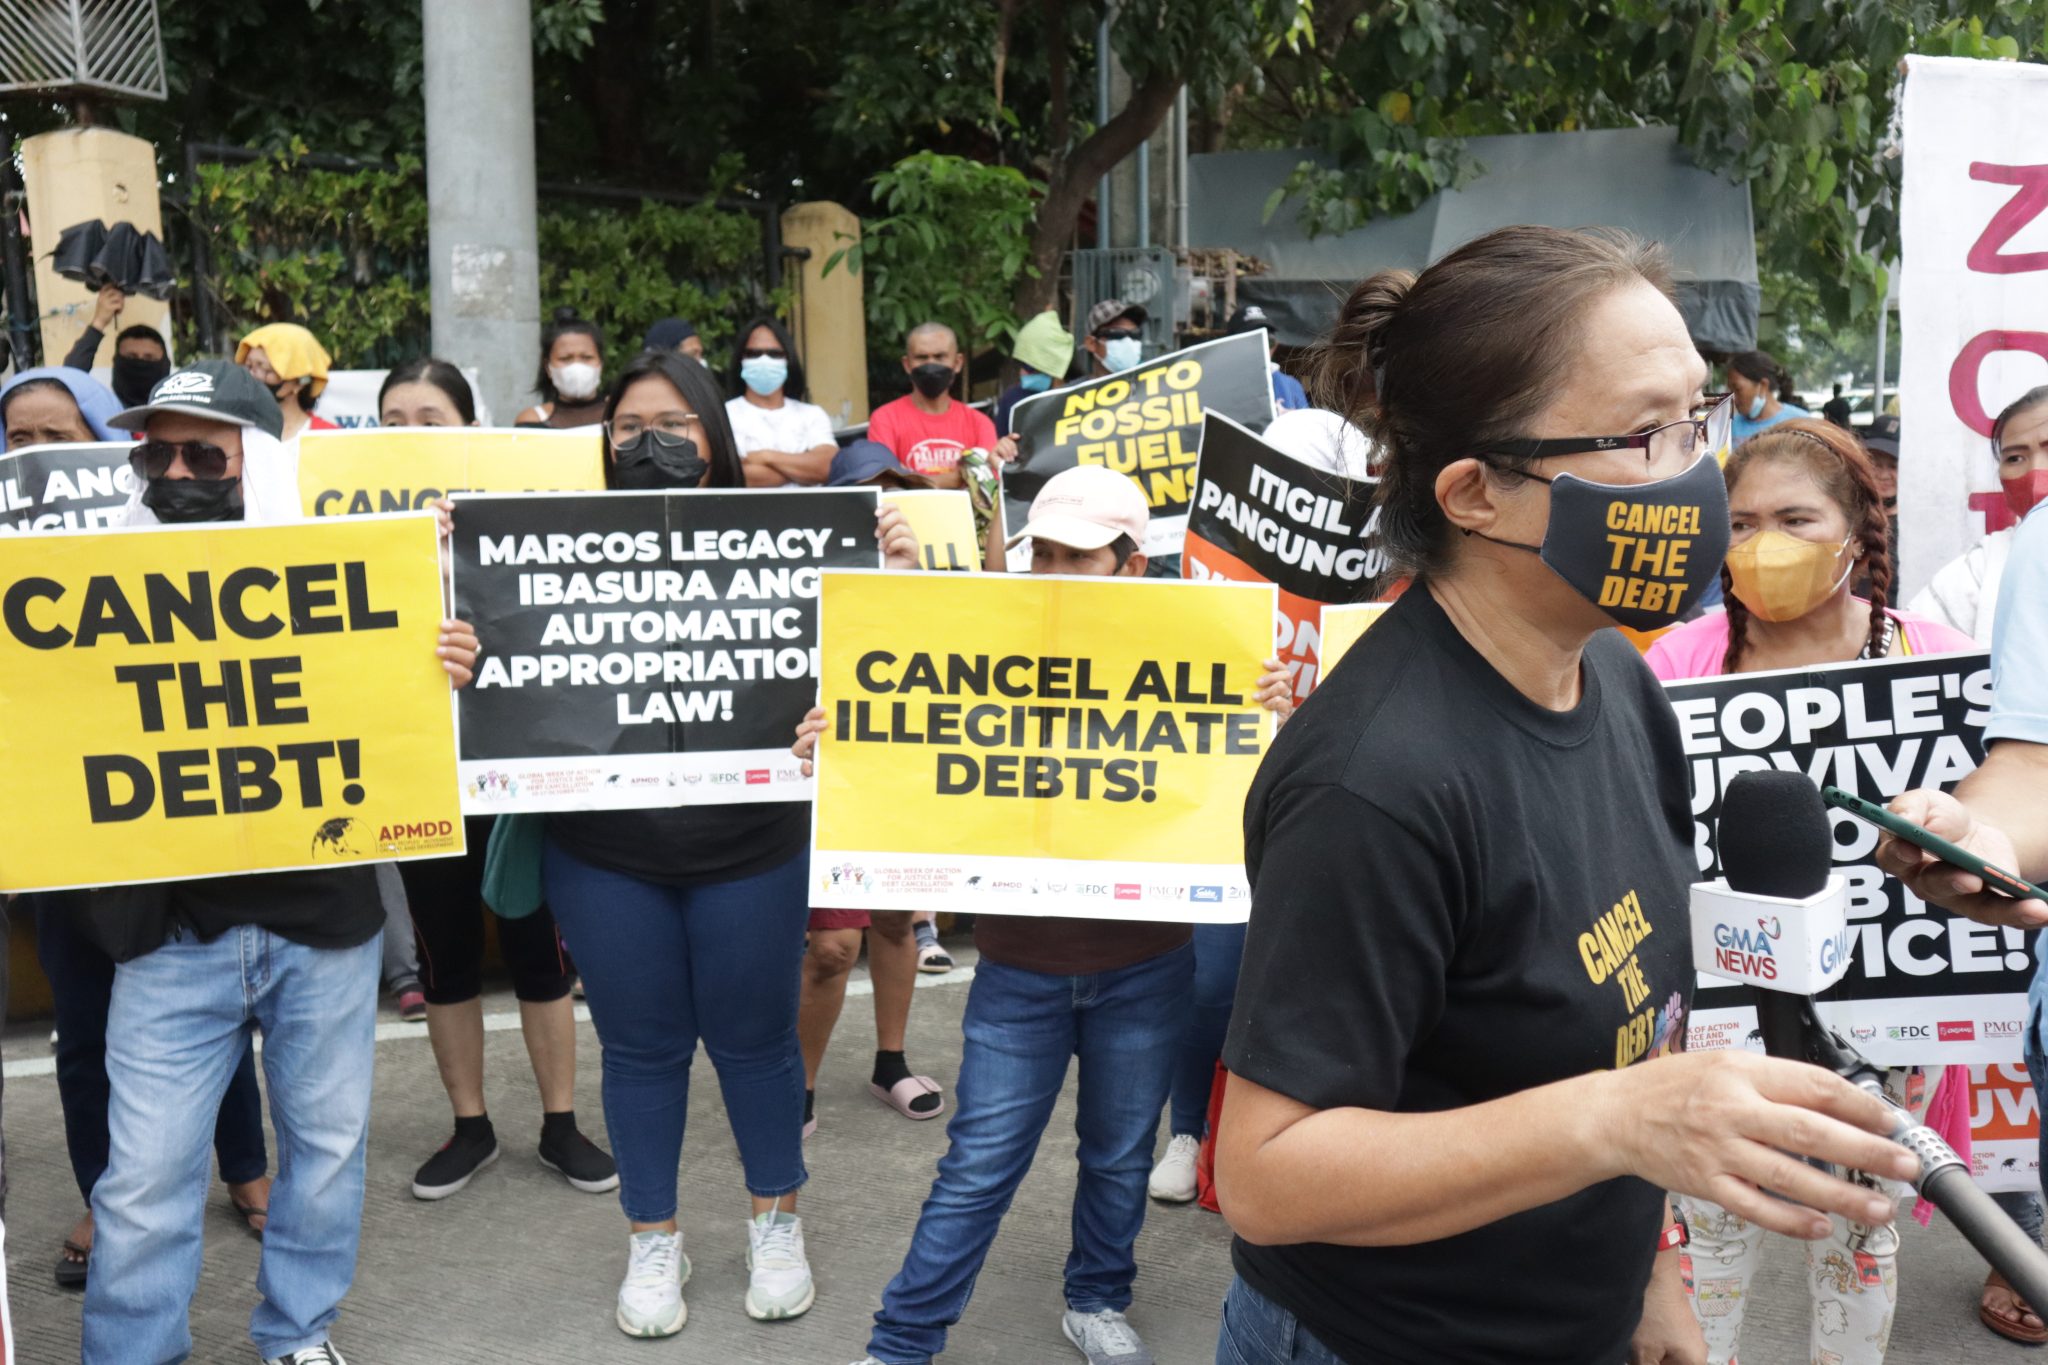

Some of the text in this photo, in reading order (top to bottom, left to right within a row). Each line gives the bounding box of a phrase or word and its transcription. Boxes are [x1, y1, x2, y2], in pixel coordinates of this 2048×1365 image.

[1063, 360, 1203, 418] NO TO
[1054, 391, 1205, 447] FOSSIL
[1077, 430, 1198, 474] FUEL
[1249, 463, 1351, 536] ITIGIL
[1606, 501, 1701, 535] CANCEL
[478, 532, 661, 566] MARCOS
[670, 528, 833, 561] LEGACY
[1606, 534, 1691, 577] THE
[2, 561, 399, 650] CANCEL
[519, 570, 718, 606] IBASURA
[1598, 575, 1689, 615] DEBT
[540, 608, 803, 646] AUTOMATIC
[115, 655, 309, 733] THE
[855, 650, 1109, 700] CANCEL
[1125, 659, 1244, 706] ALL
[617, 690, 735, 725] LAW!
[836, 699, 1261, 756] ILLEGITIMATE
[83, 738, 366, 824] DEBT!
[719, 773, 740, 782] FDC
[936, 752, 1159, 804] DEBTS!
[379, 820, 453, 841] APMDD
[1086, 884, 1108, 894] FDC
[1577, 889, 1653, 985] CANCEL
[1714, 923, 1774, 956] GMA
[1616, 953, 1651, 1014] THE
[1715, 947, 1778, 980] NEWS
[1615, 1006, 1656, 1070] DEBT
[1708, 1022, 1740, 1031] ACTION
[1900, 1025, 1930, 1038] FDC
[1984, 1020, 2023, 1033] PMCJ
